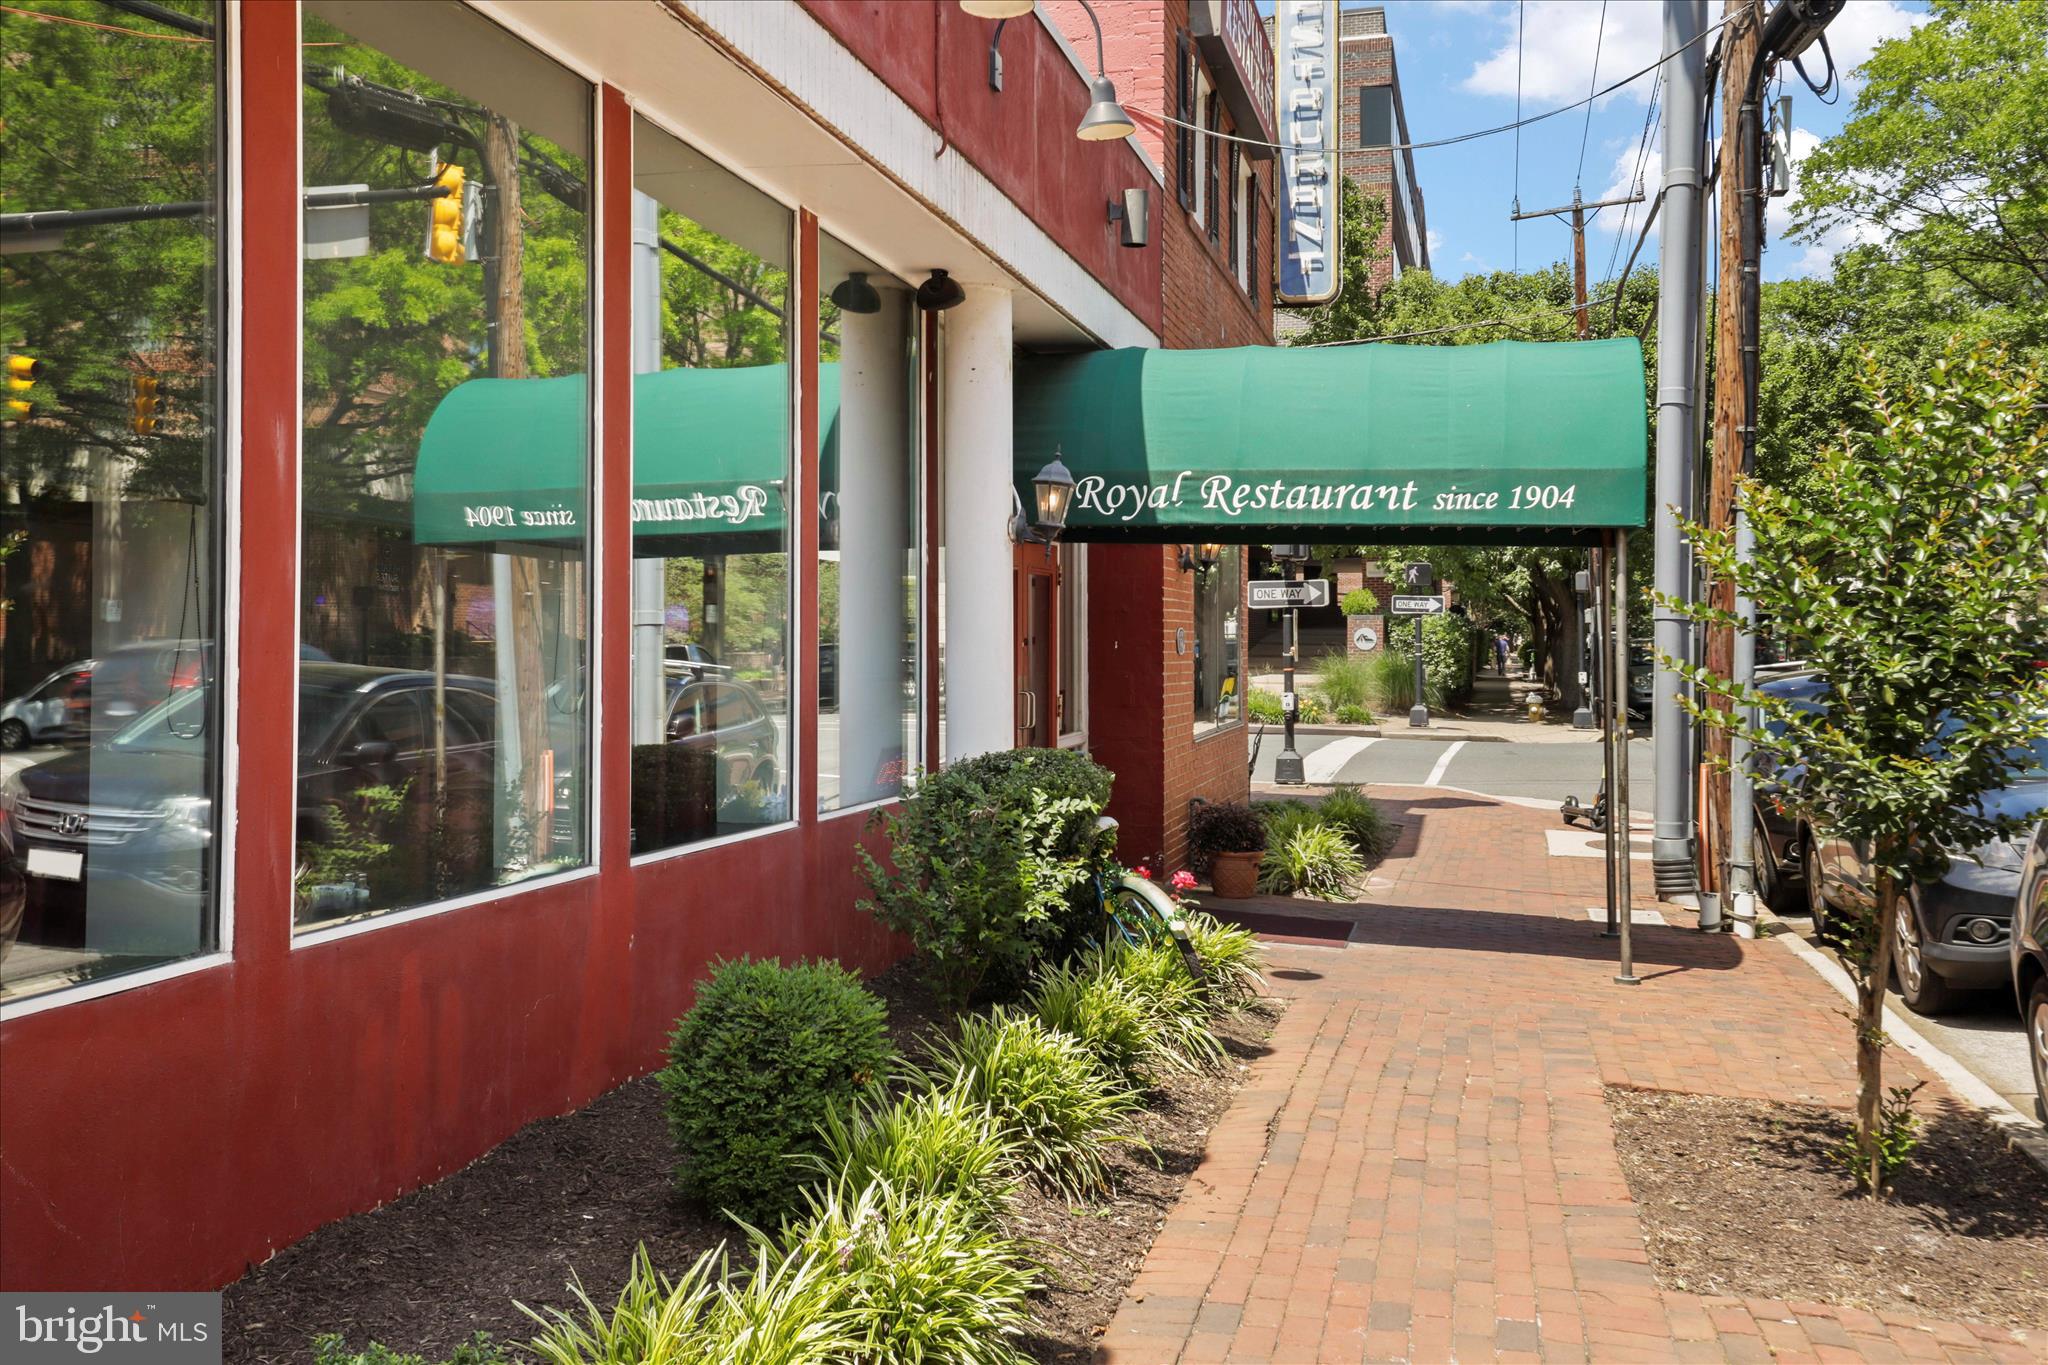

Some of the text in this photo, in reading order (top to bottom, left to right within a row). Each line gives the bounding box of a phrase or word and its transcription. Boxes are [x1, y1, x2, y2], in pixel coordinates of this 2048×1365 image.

[1288, 0, 1325, 275] ESTAURANT
[1076, 470, 1576, 521] Royal Restaurant since 1904
[1256, 588, 1302, 599] ONE WAY
[1397, 600, 1428, 608] ONE WAY
